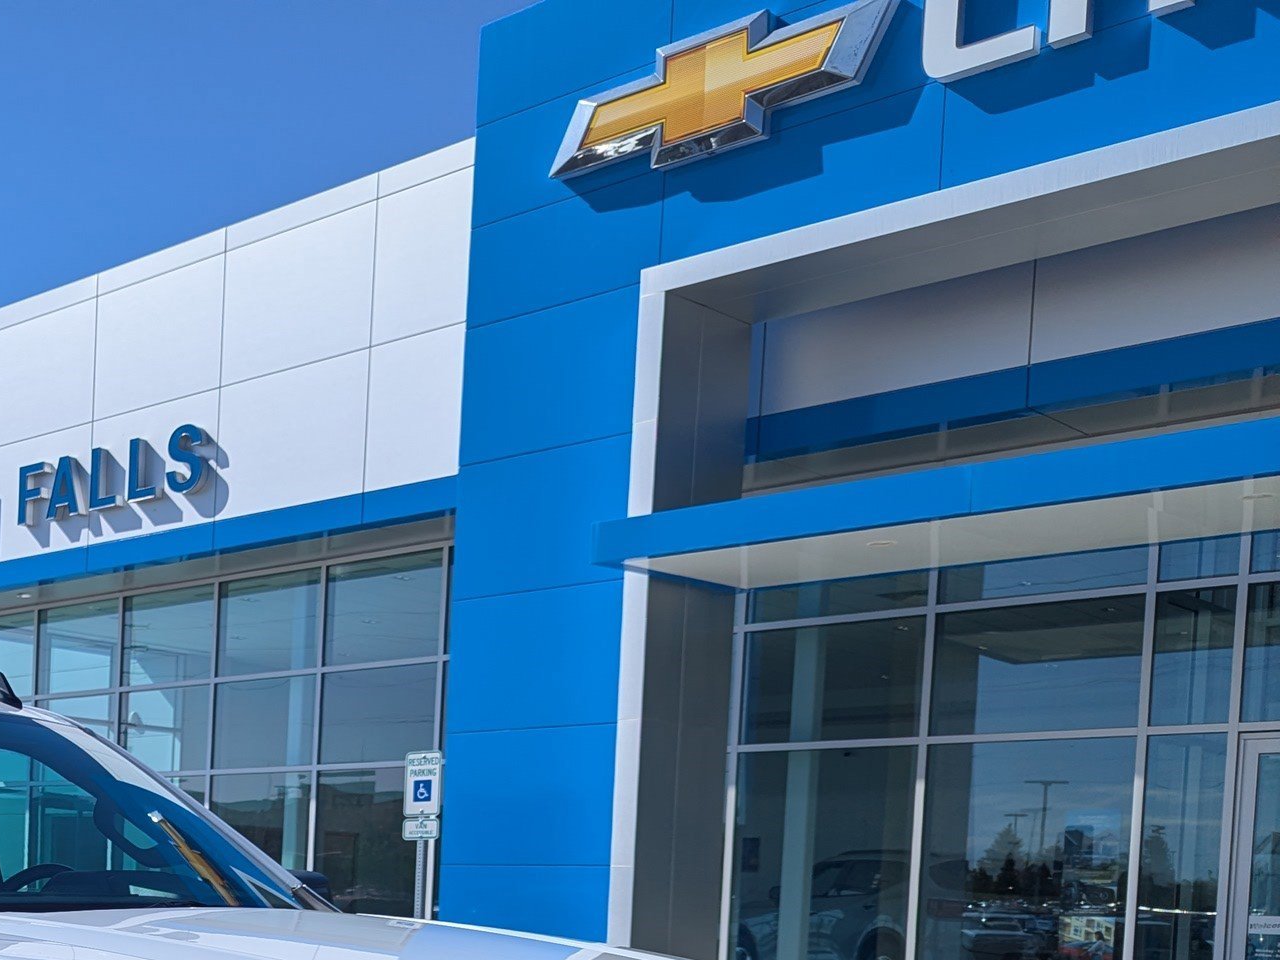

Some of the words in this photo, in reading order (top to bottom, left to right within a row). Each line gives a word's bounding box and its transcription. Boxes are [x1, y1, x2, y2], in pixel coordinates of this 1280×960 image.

[17, 424, 209, 526] FALLS
[408, 757, 439, 767] RESERVED
[409, 768, 437, 778] PARKING
